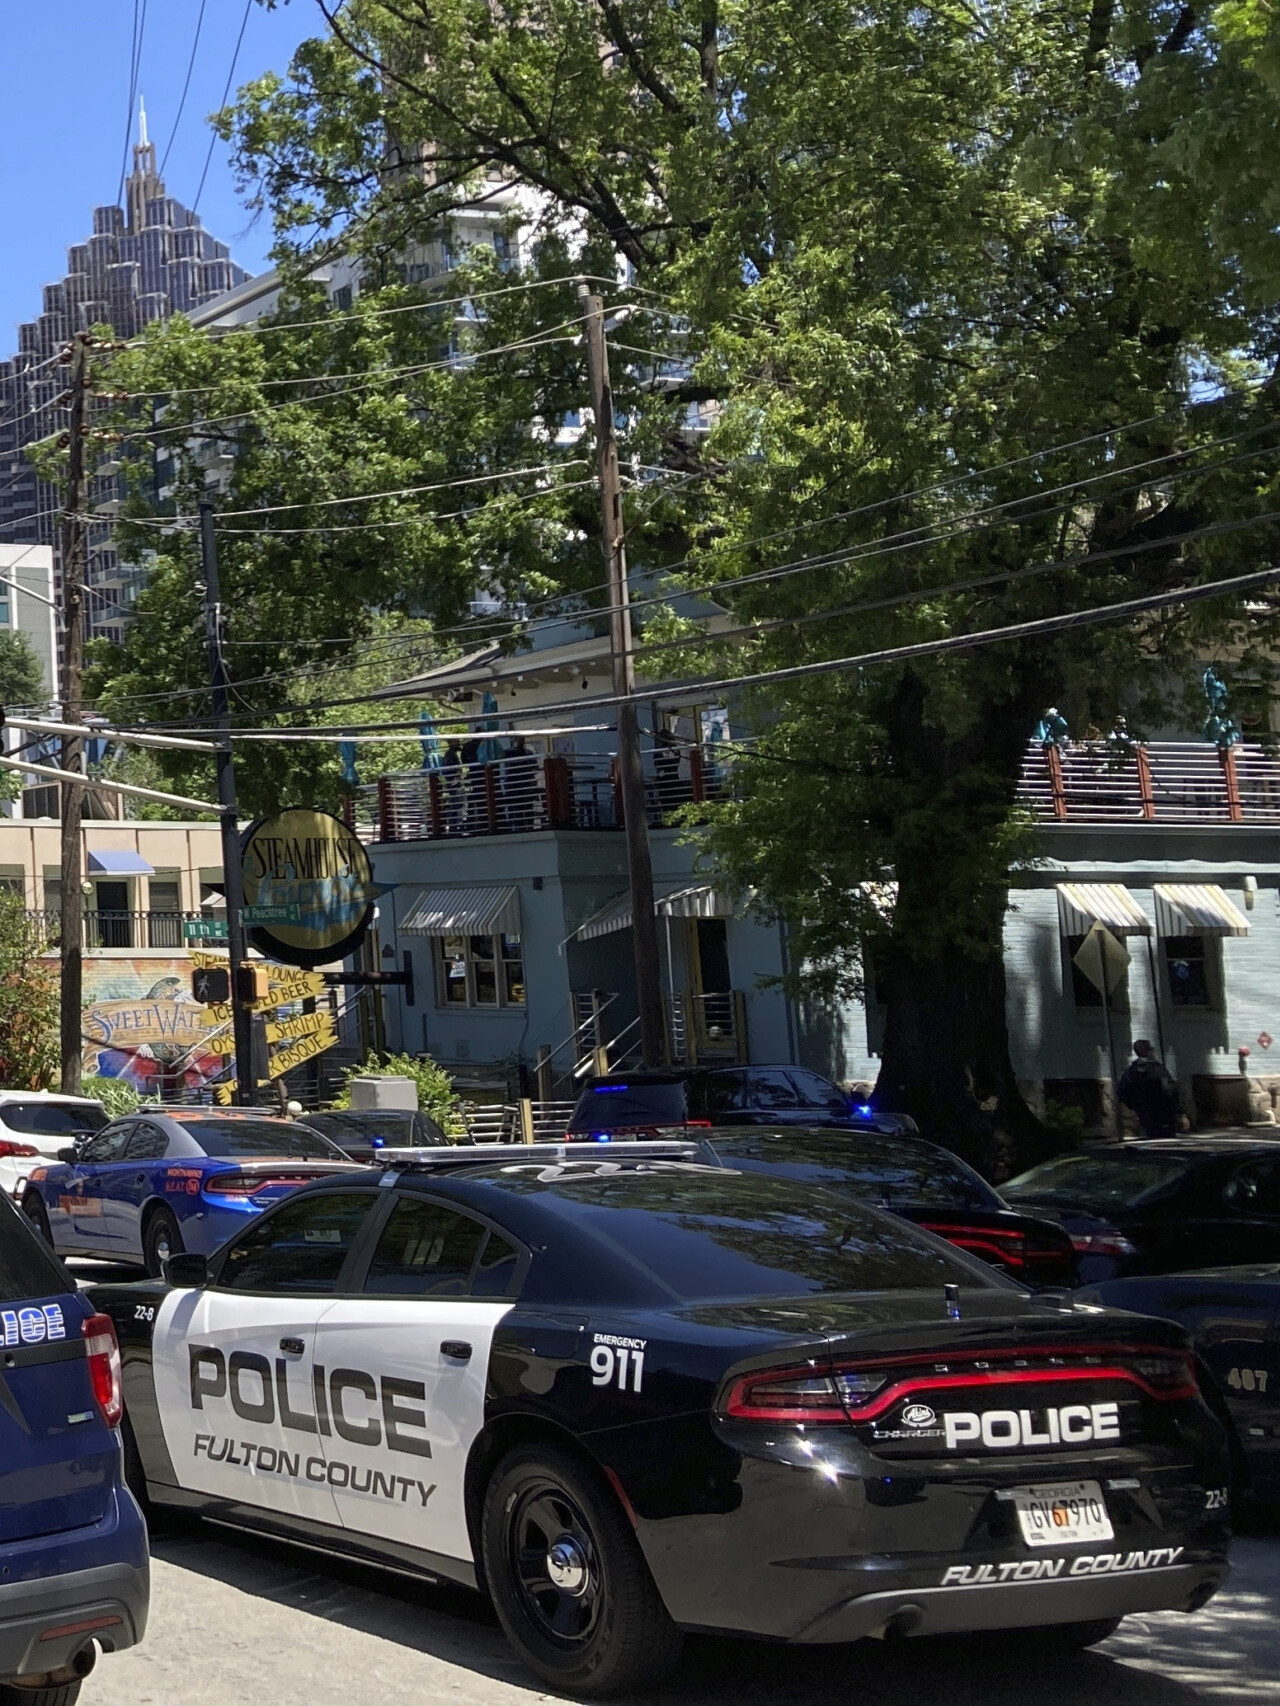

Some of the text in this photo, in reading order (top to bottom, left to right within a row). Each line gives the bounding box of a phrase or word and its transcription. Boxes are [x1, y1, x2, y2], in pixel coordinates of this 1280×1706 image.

[252, 837, 362, 879] STEAMHOUSE
[252, 906, 287, 919] Peachtree
[266, 965, 310, 983] LOUNGE
[281, 981, 314, 1002] BEER
[274, 1012, 325, 1039] SHRIMP
[278, 1035, 327, 1069] BISQUE
[134, 1305, 154, 1321] 22-8
[593, 1333, 648, 1350] EMERGENCY
[590, 1345, 644, 1393] 911
[188, 1343, 432, 1459] POLICE
[943, 1403, 1120, 1449] POLICE
[194, 1433, 437, 1508] FULTON COUNTY
[1034, 1486, 1081, 1499] GEORGIA
[1030, 1498, 1102, 1529] GV6797Q
[940, 1546, 1184, 1586] FULTON COUNTY
